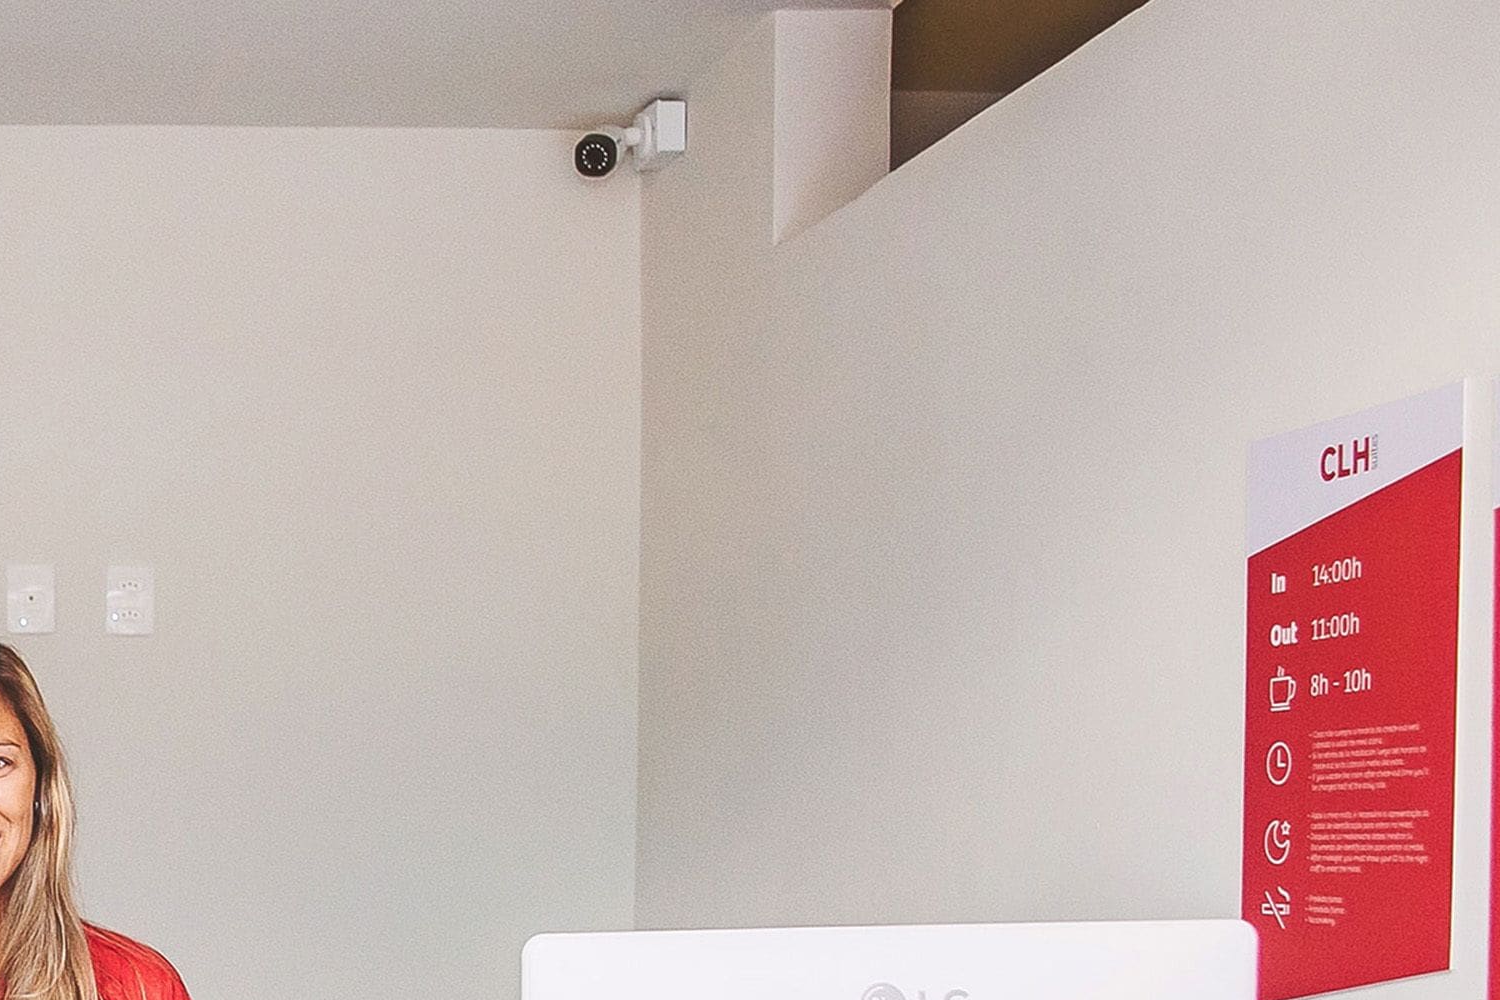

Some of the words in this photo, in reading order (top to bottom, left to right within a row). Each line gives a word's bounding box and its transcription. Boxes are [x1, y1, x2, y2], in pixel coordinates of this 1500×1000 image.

[1321, 436, 1370, 481] CLH
[1271, 573, 1286, 594] In
[1312, 556, 1362, 587] 14:00h
[1270, 621, 1299, 647] Out
[1311, 612, 1360, 641] 11:00h
[1310, 673, 1329, 697] 8h
[1343, 668, 1372, 693] 10h
